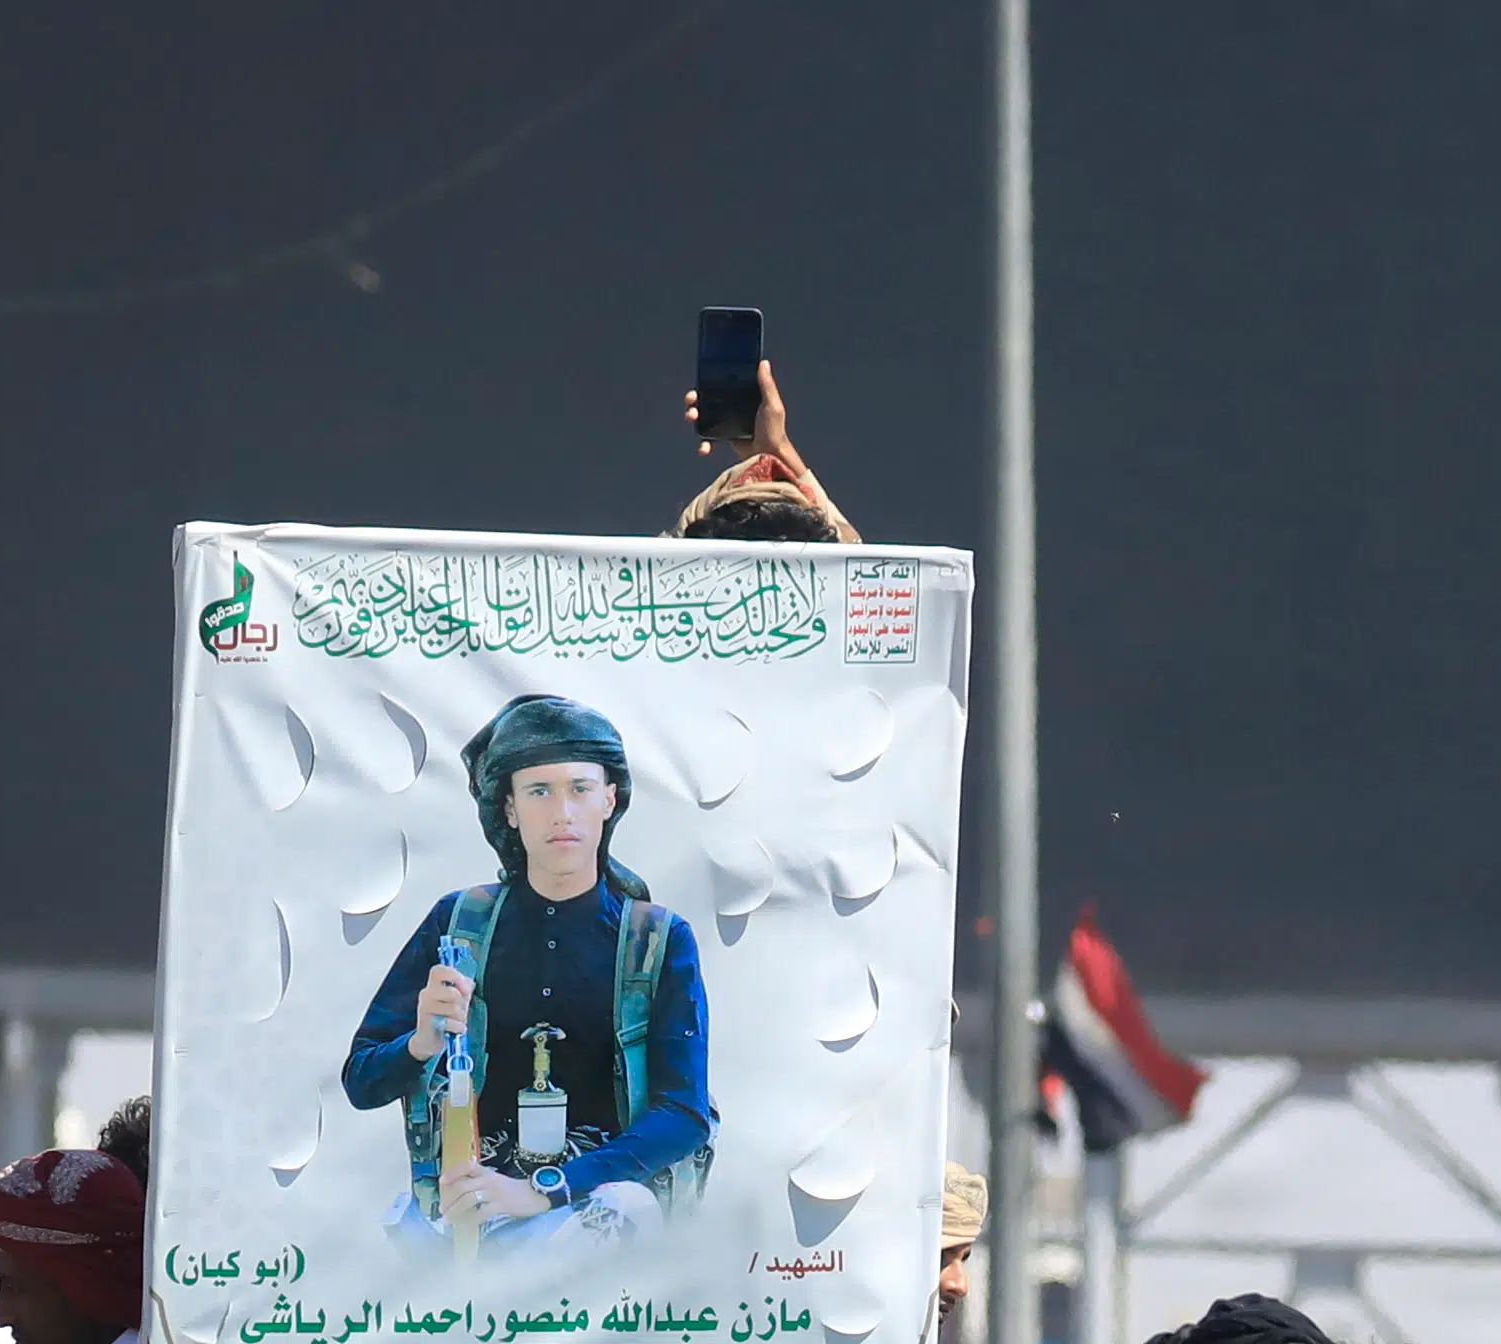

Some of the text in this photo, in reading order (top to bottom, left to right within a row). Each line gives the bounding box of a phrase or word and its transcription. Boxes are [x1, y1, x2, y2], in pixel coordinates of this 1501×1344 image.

[205, 602, 245, 628] صدقوا
[765, 1250, 844, 1281] الشهيد
[475, 1297, 591, 1343] منصور
[729, 1296, 812, 1344] مازن
